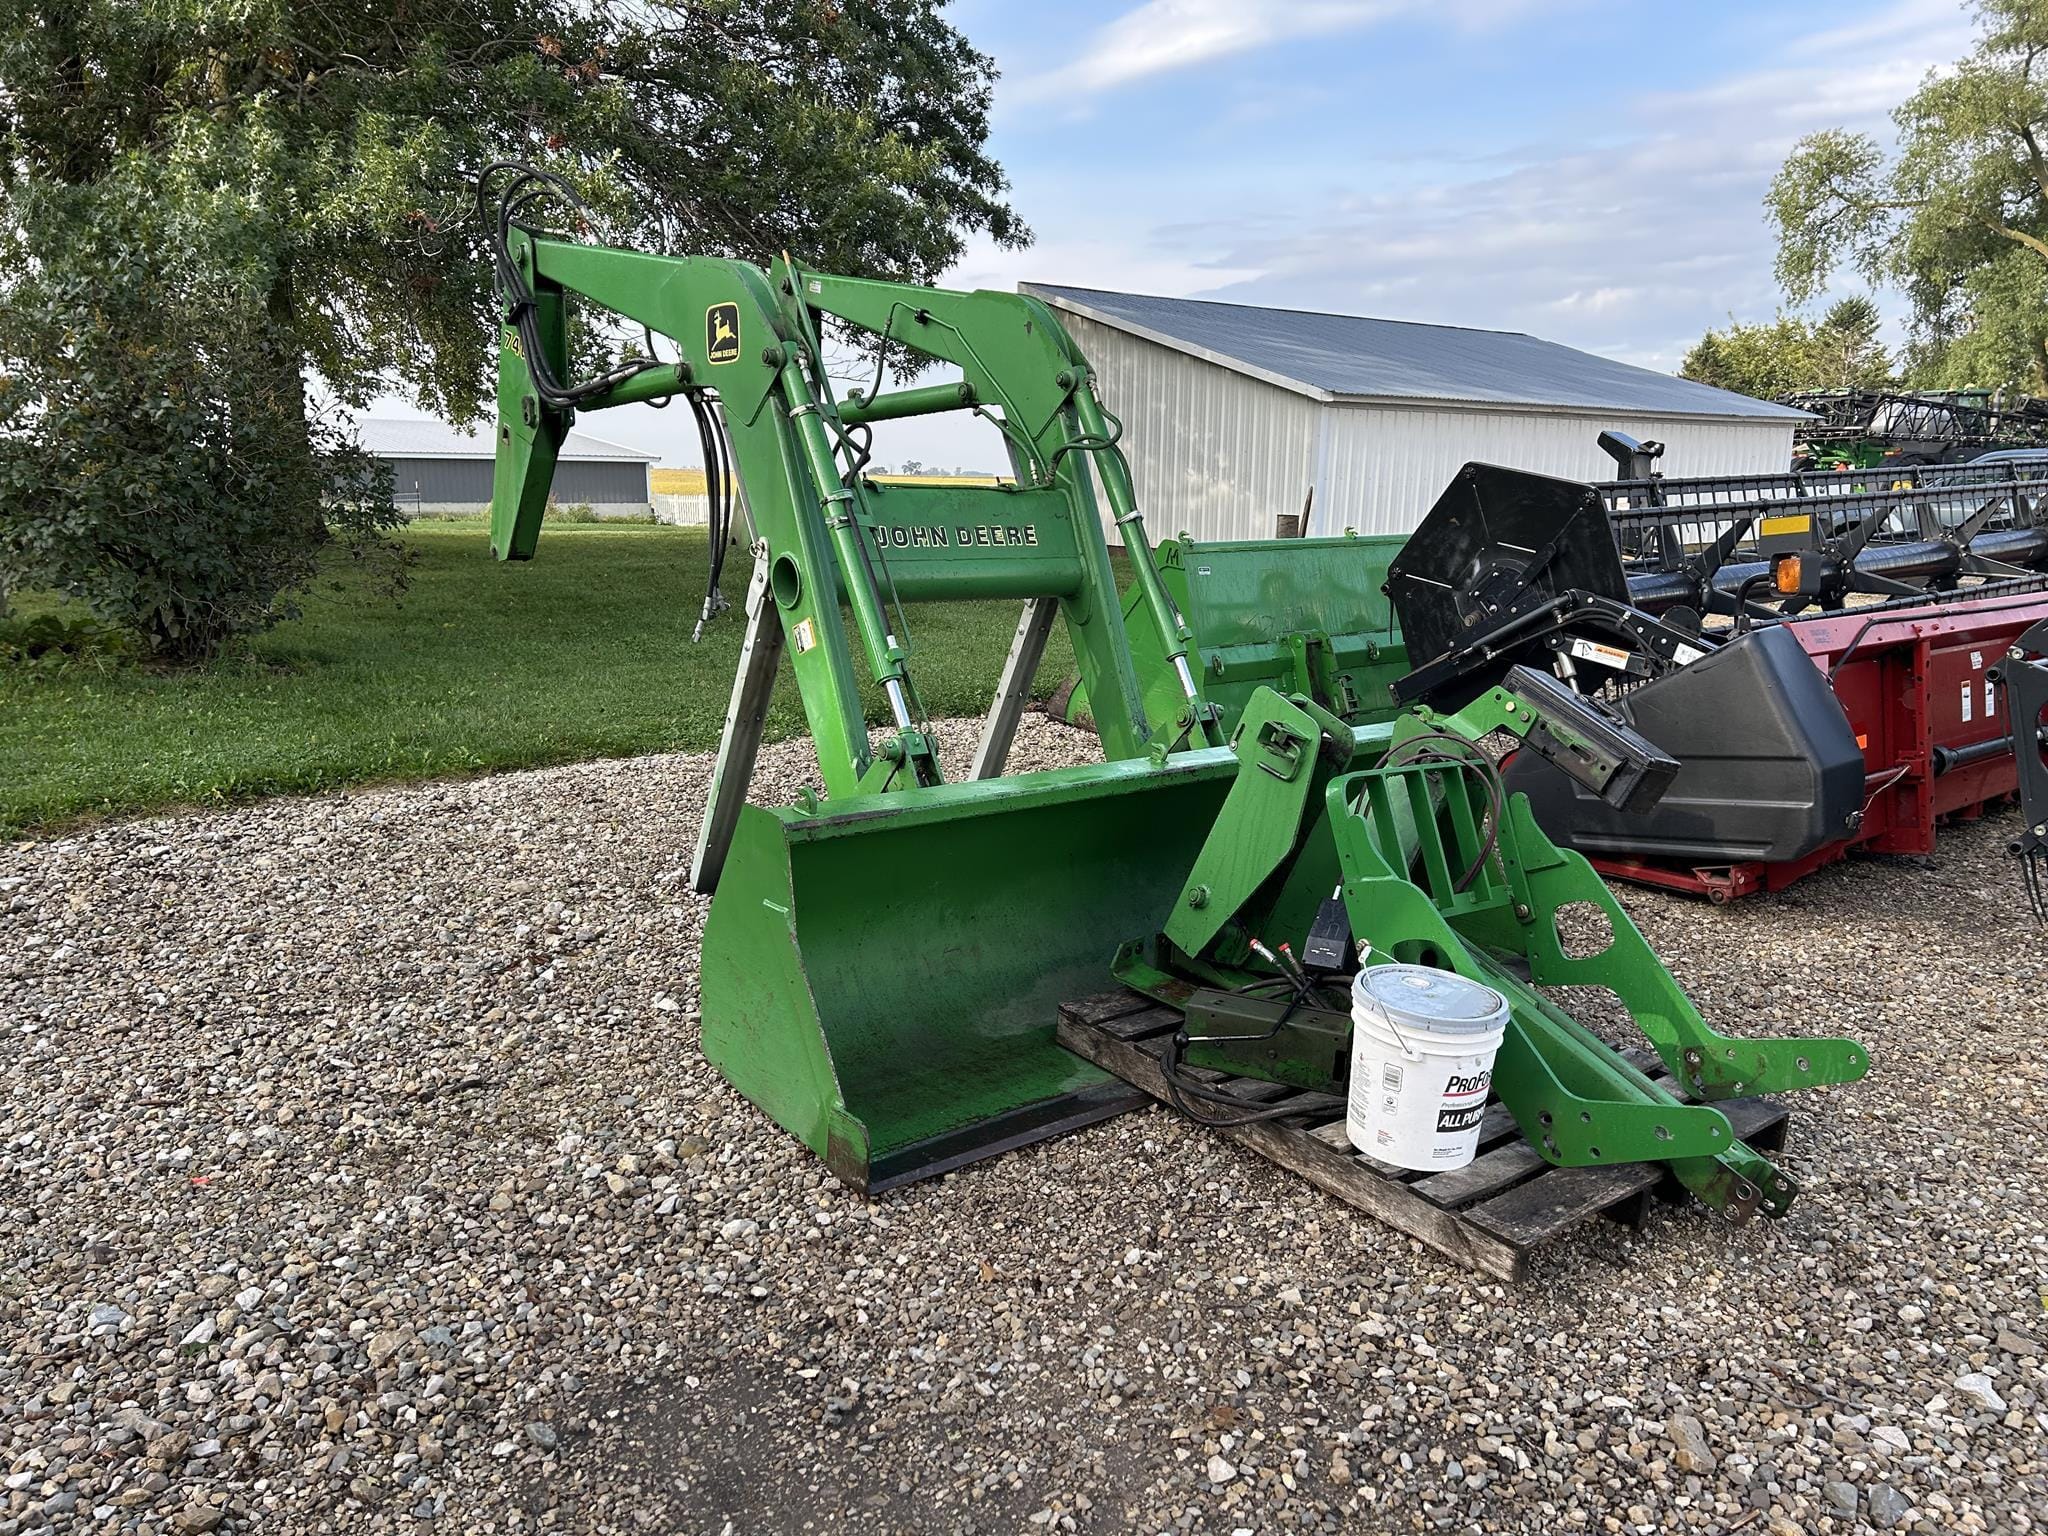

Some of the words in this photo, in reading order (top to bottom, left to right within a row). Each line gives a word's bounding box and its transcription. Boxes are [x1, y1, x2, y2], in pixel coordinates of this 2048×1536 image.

[876, 525, 950, 548] JOHN
[955, 524, 1039, 547] DEERE
[1165, 547, 1180, 566] M
[1438, 1113, 1462, 1128] ALL
